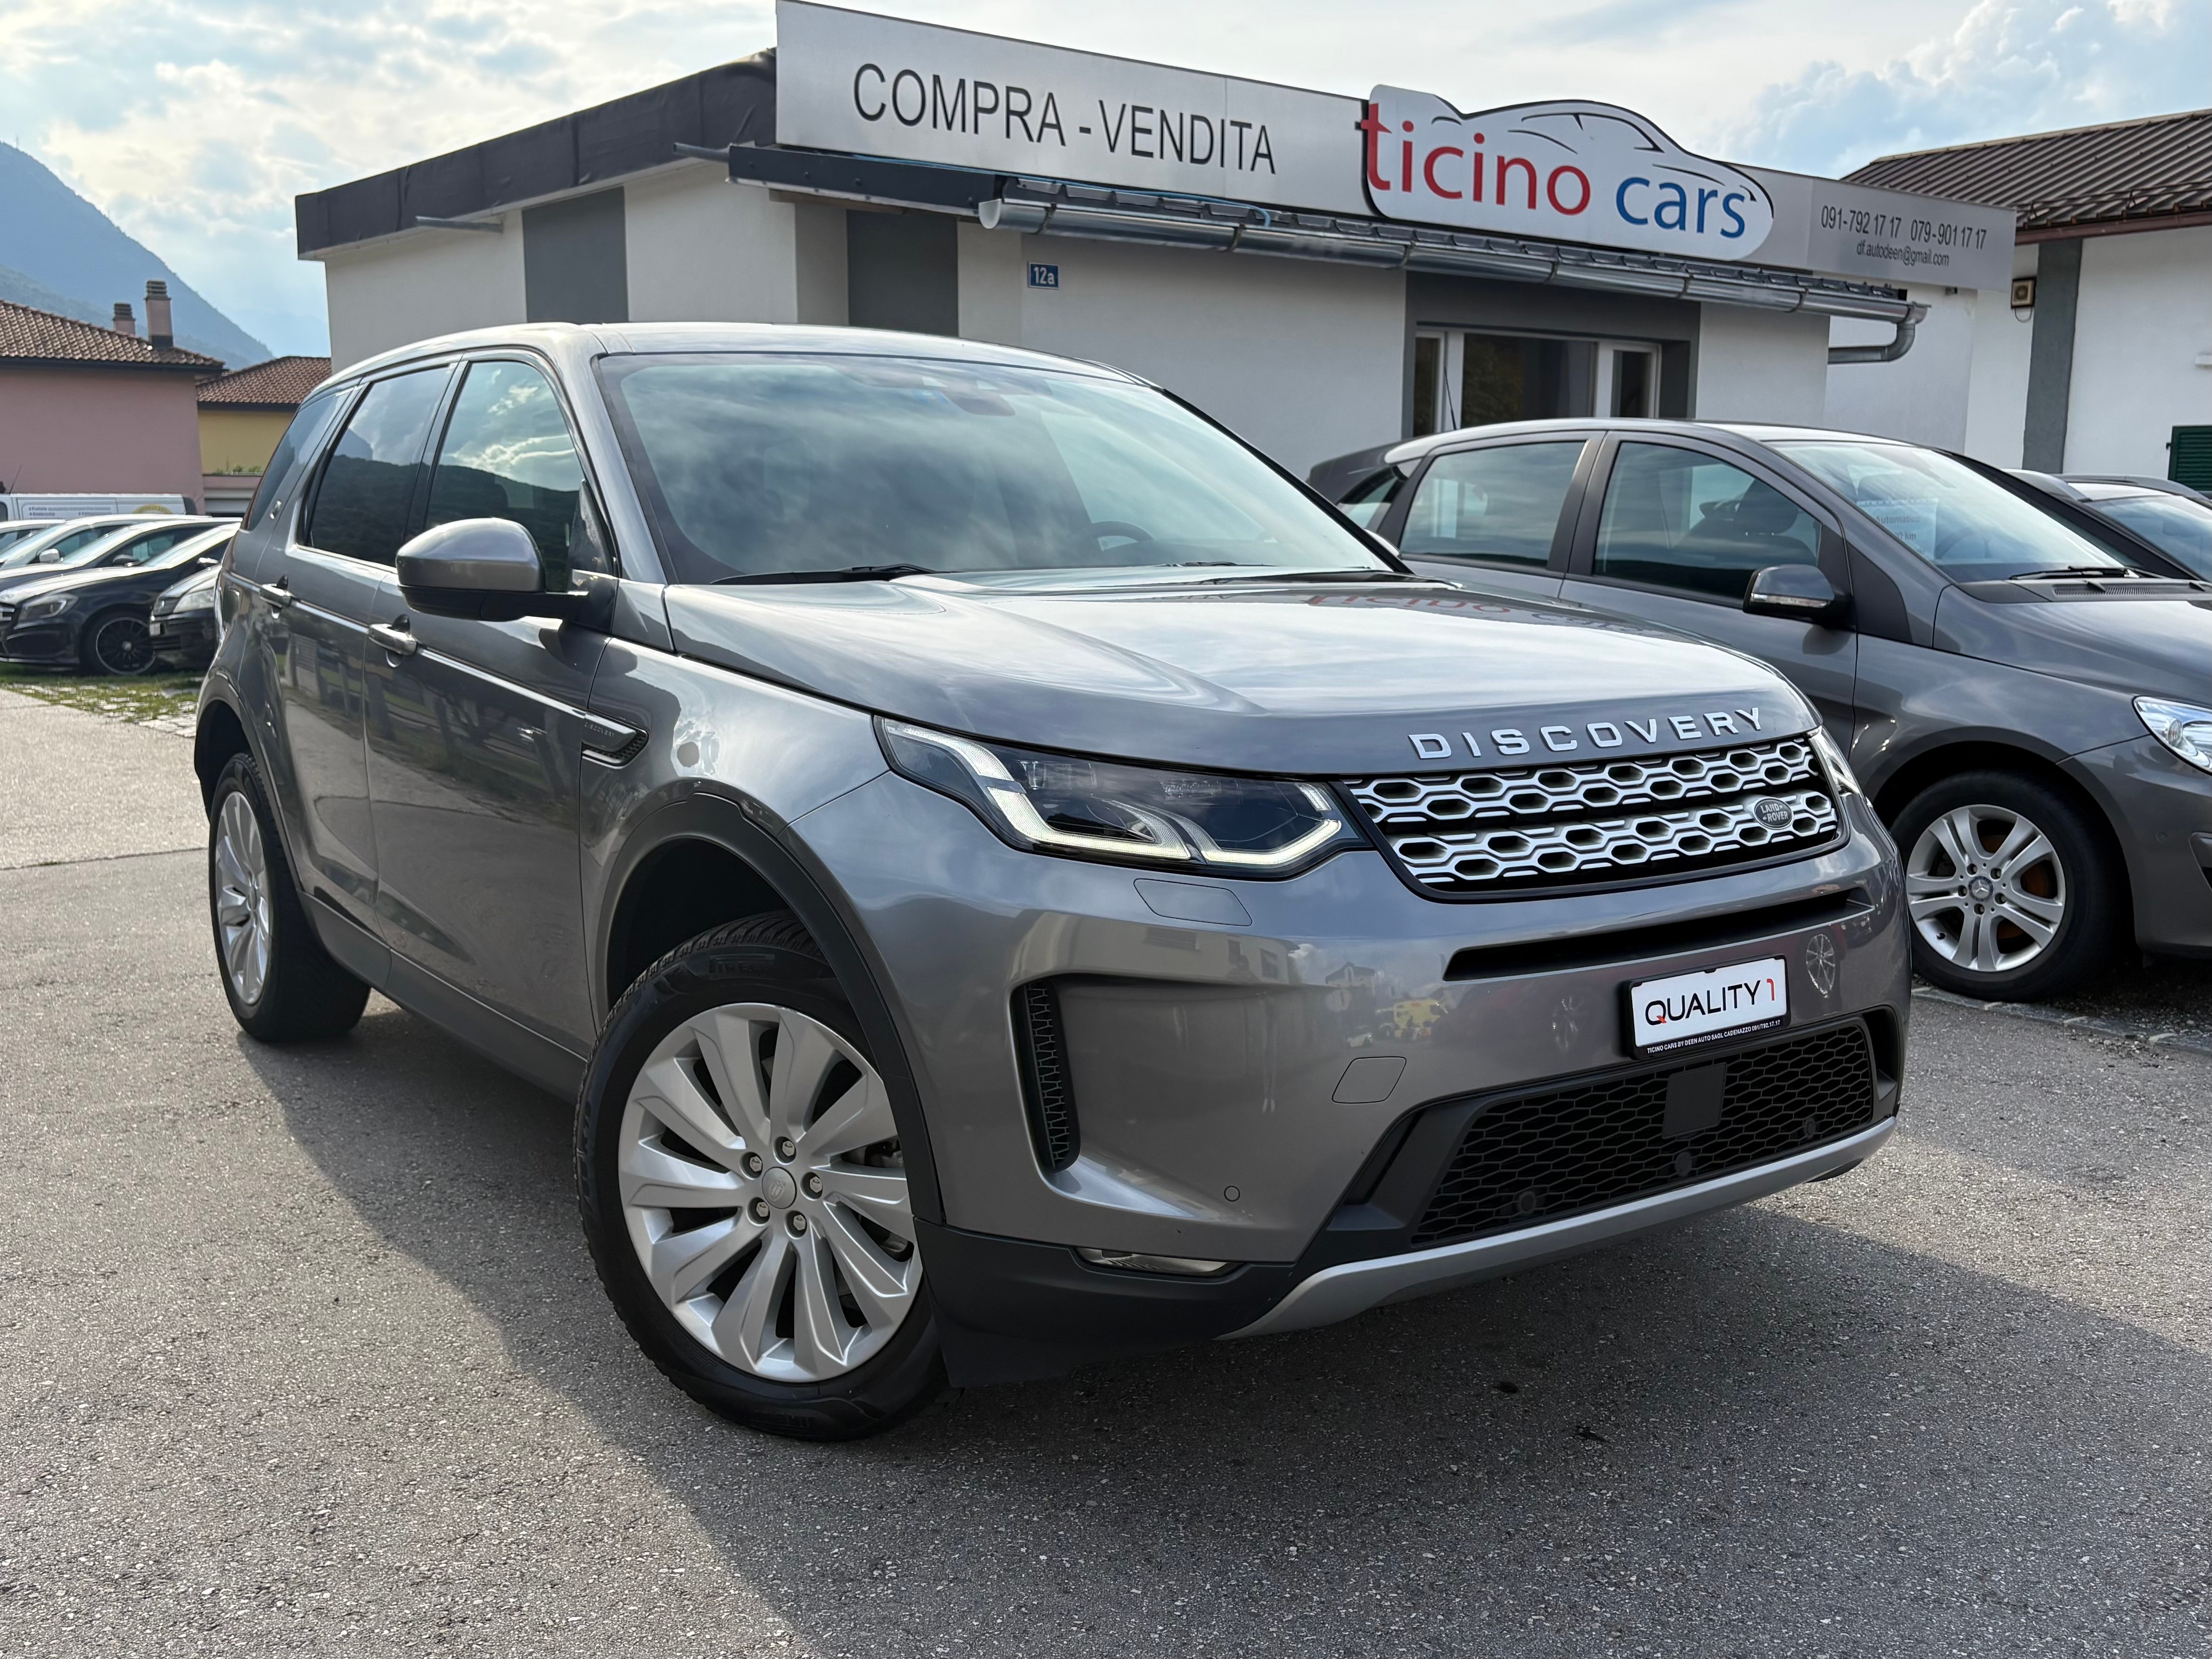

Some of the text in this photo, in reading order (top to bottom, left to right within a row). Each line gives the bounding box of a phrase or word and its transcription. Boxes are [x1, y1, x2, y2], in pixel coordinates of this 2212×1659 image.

[852, 63, 1066, 147] COMPRA
[1098, 99, 1276, 175] VENDITA
[1361, 102, 1746, 239] ticino cars
[1821, 205, 1987, 250] 091-792 17 17 079-901 17 17
[1856, 239, 1949, 267] df.autodeen@gmail.com
[1034, 267, 1055, 285] 12a
[1408, 707, 1760, 759] DISCOVERY
[1760, 803, 1780, 813] LAND
[1767, 811, 1788, 822] ROVER
[1645, 980, 1761, 1026] QUALITY
[1647, 1045, 1664, 1054] TICINO
[1664, 1042, 1677, 1050] CARS
[1685, 1037, 1698, 1045] DEEN
[1698, 1035, 1711, 1043] AUTO
[1724, 1026, 1752, 1037] CADENAZZO
